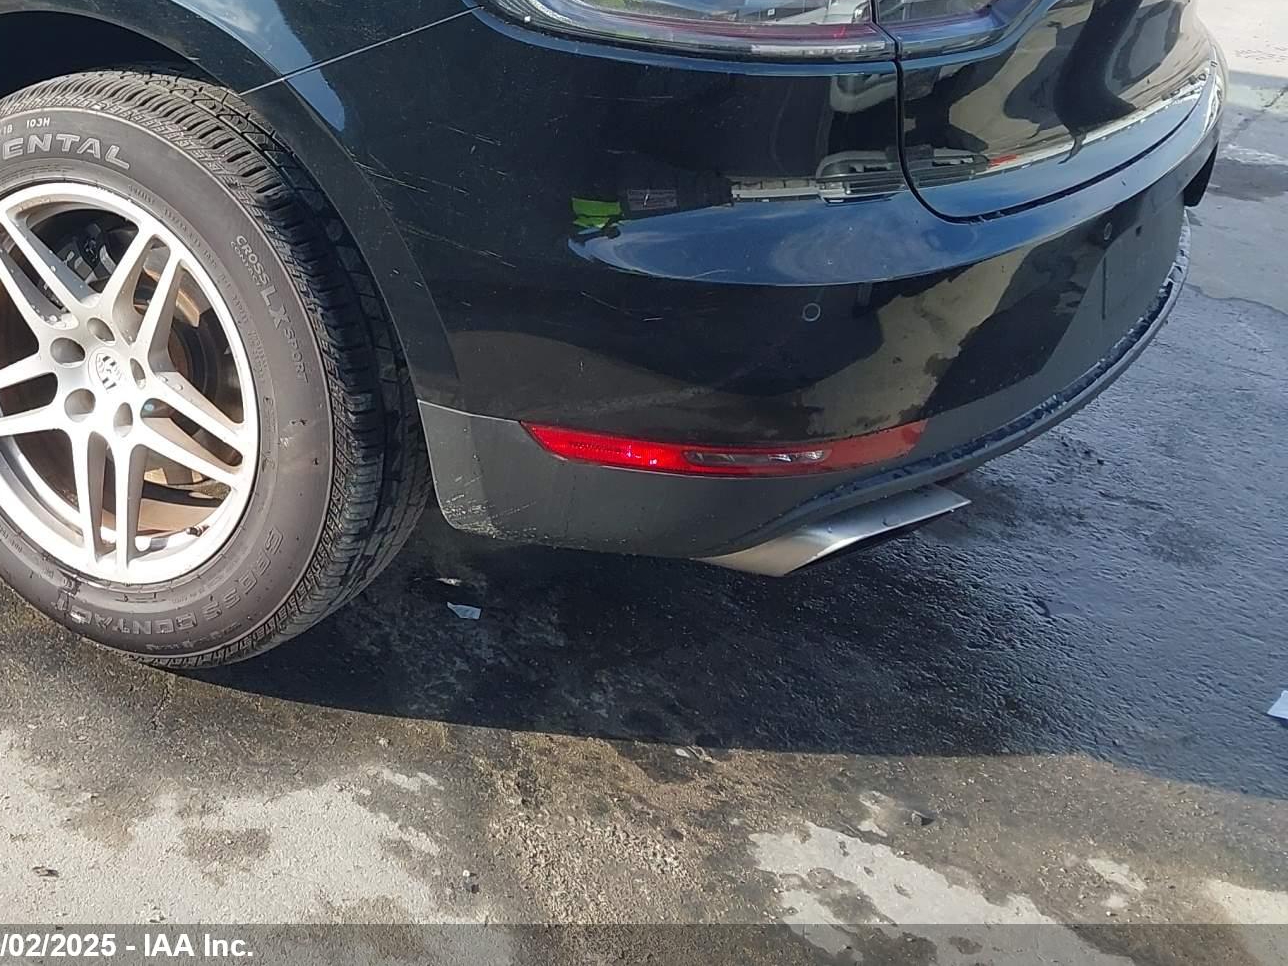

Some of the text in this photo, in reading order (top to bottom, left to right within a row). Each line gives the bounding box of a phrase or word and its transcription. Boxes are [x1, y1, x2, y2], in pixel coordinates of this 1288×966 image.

[25, 116, 51, 129] 103H
[236, 235, 270, 286] CROSS
[283, 328, 309, 384] SPORT
